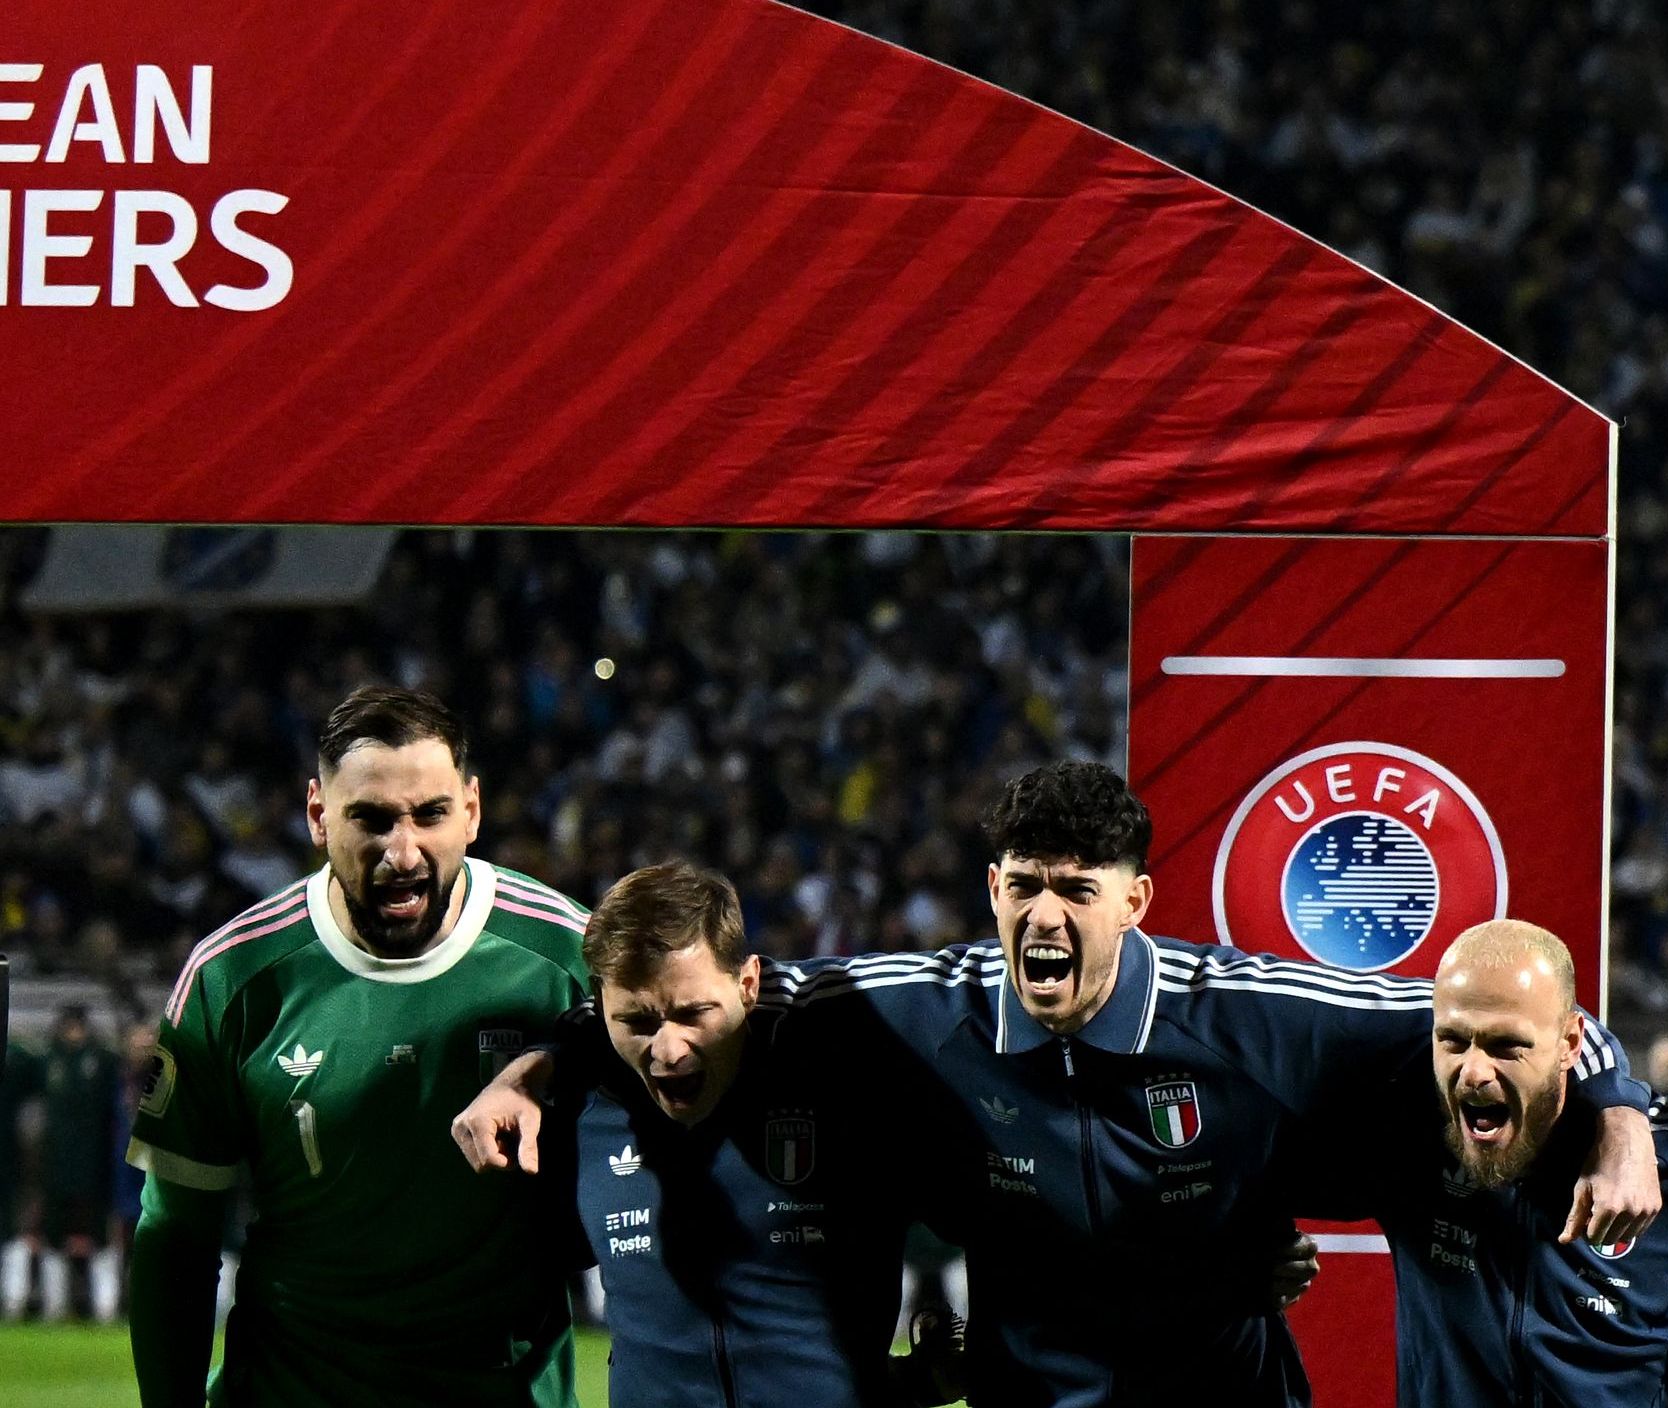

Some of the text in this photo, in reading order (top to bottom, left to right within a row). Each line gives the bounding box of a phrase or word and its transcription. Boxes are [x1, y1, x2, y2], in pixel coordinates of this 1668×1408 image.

[1274, 763, 1440, 831] UEFA
[1149, 1087, 1192, 1104] ITALIA
[294, 1101, 323, 1178] 1
[1002, 1157, 1035, 1174] TIM
[989, 1173, 1038, 1195] Poste
[1160, 1184, 1190, 1203] eni
[621, 1208, 650, 1226] TIM
[769, 1226, 800, 1243] eni
[609, 1234, 652, 1255] Poste
[1576, 1294, 1604, 1312] eni
